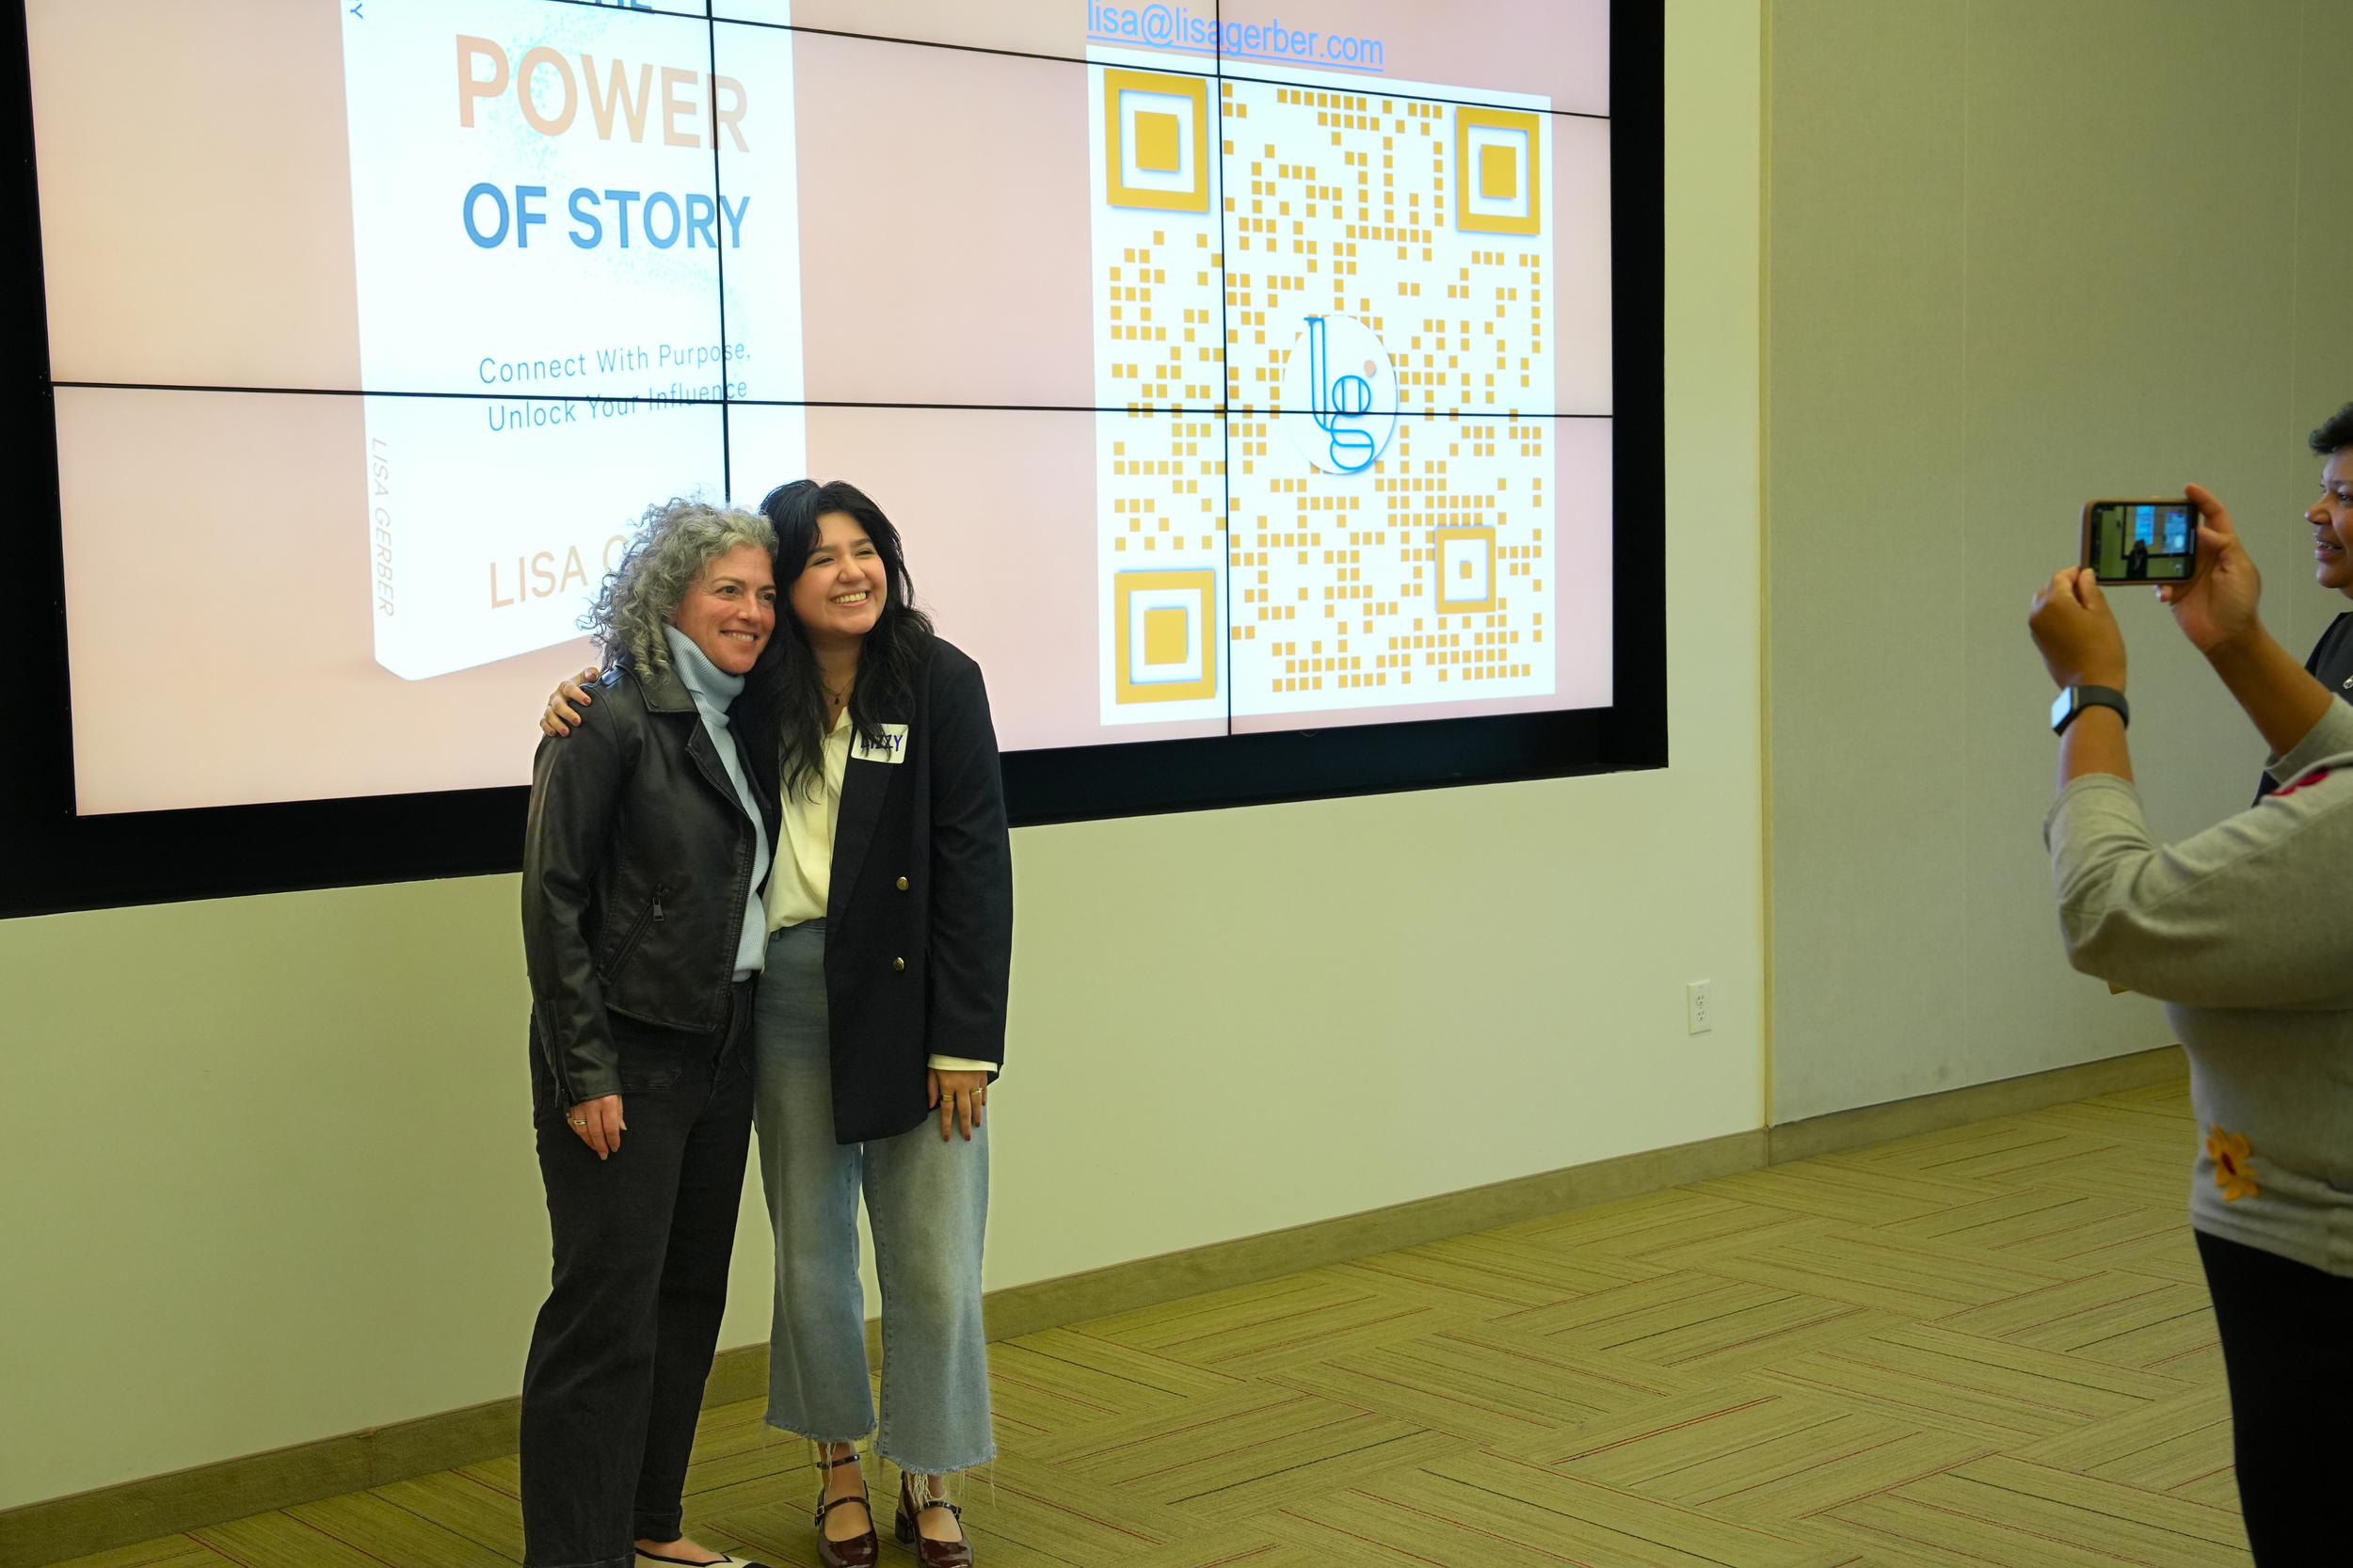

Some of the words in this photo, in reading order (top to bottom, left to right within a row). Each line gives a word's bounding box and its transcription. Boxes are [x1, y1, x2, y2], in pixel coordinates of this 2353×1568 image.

[1087, 0, 1384, 65] lisa@lisagerber.com
[456, 34, 750, 152] POWER
[463, 182, 547, 248] OF
[568, 187, 750, 249] STORY
[480, 353, 586, 384] Connect
[597, 344, 648, 373] With
[659, 343, 751, 369] Purpose,
[488, 399, 576, 432] Unlock
[586, 393, 639, 419] Your
[649, 381, 748, 411] Influence
[373, 438, 389, 495] LISA
[375, 507, 394, 616] GERBER
[490, 545, 588, 609] LISA
